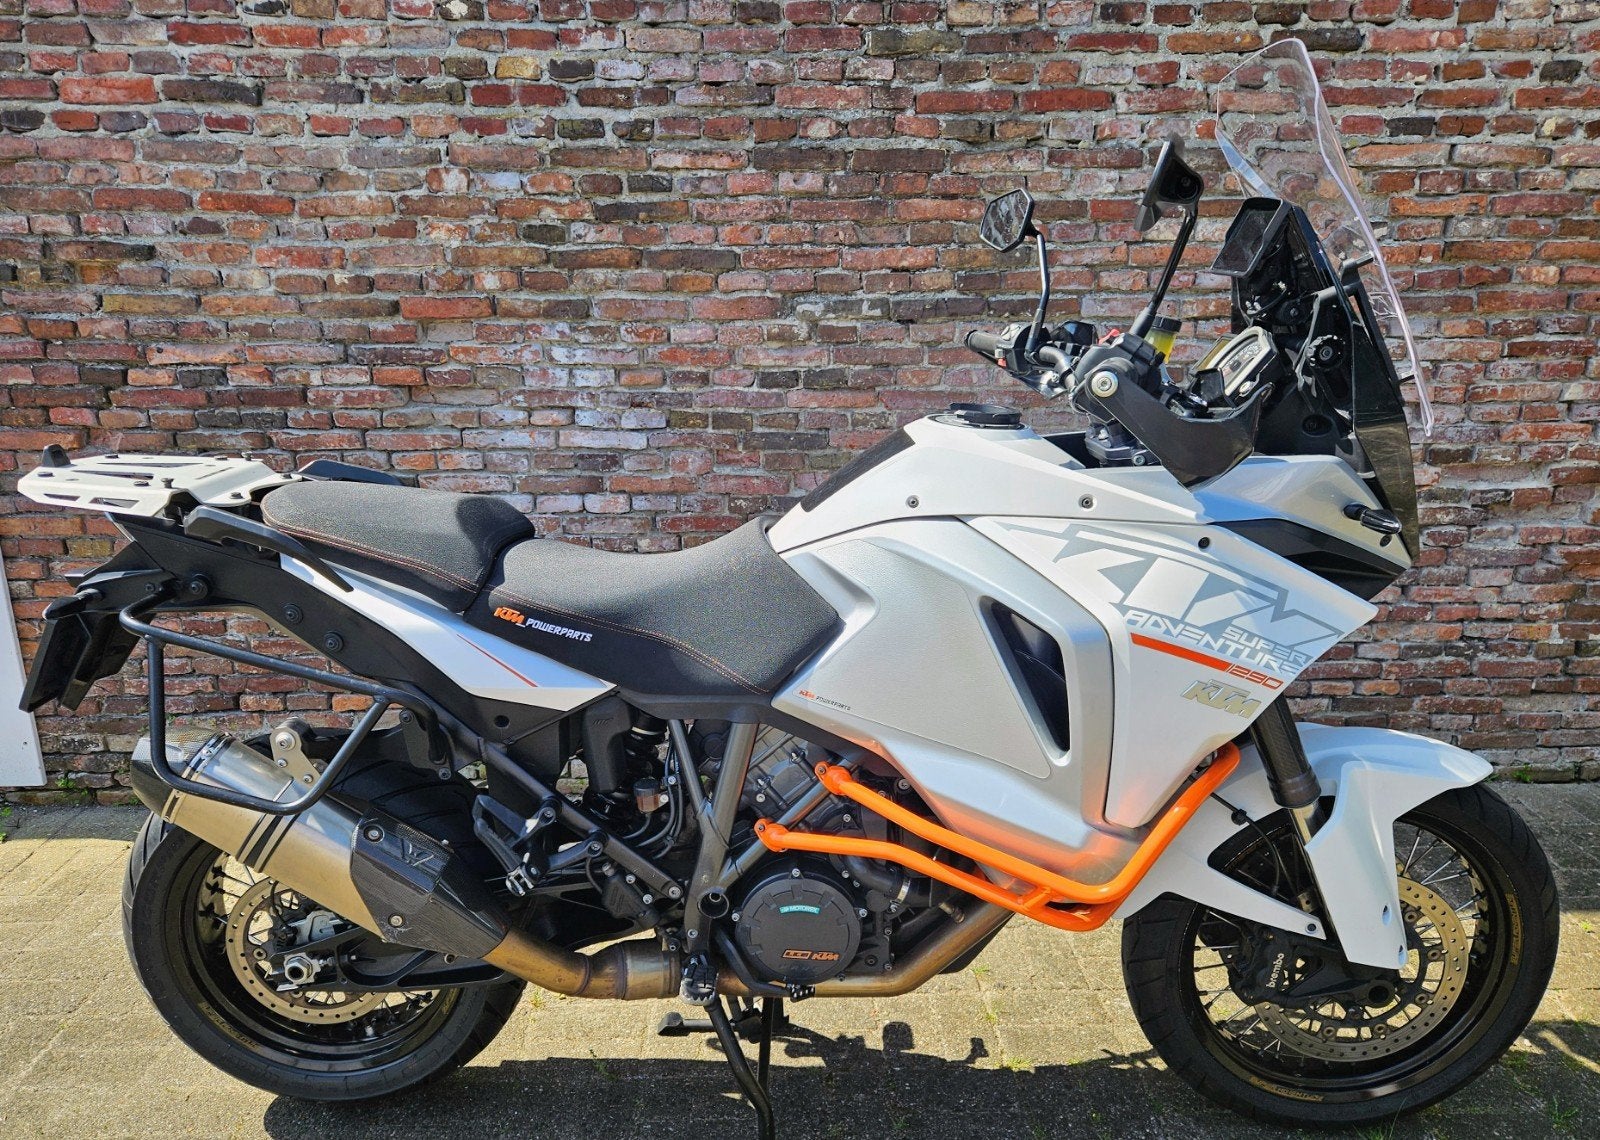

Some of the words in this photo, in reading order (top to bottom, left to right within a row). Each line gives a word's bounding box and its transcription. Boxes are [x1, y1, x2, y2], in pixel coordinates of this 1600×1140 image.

[493, 606, 525, 624] KTM
[525, 618, 593, 642] POWERPARTS
[1122, 609, 1300, 675] ADVENTURE
[1221, 625, 1309, 667] SUPER
[1226, 663, 1284, 690] 1290
[1181, 679, 1262, 719] KTM
[811, 951, 839, 961] KTM
[1265, 952, 1285, 988] brembo
